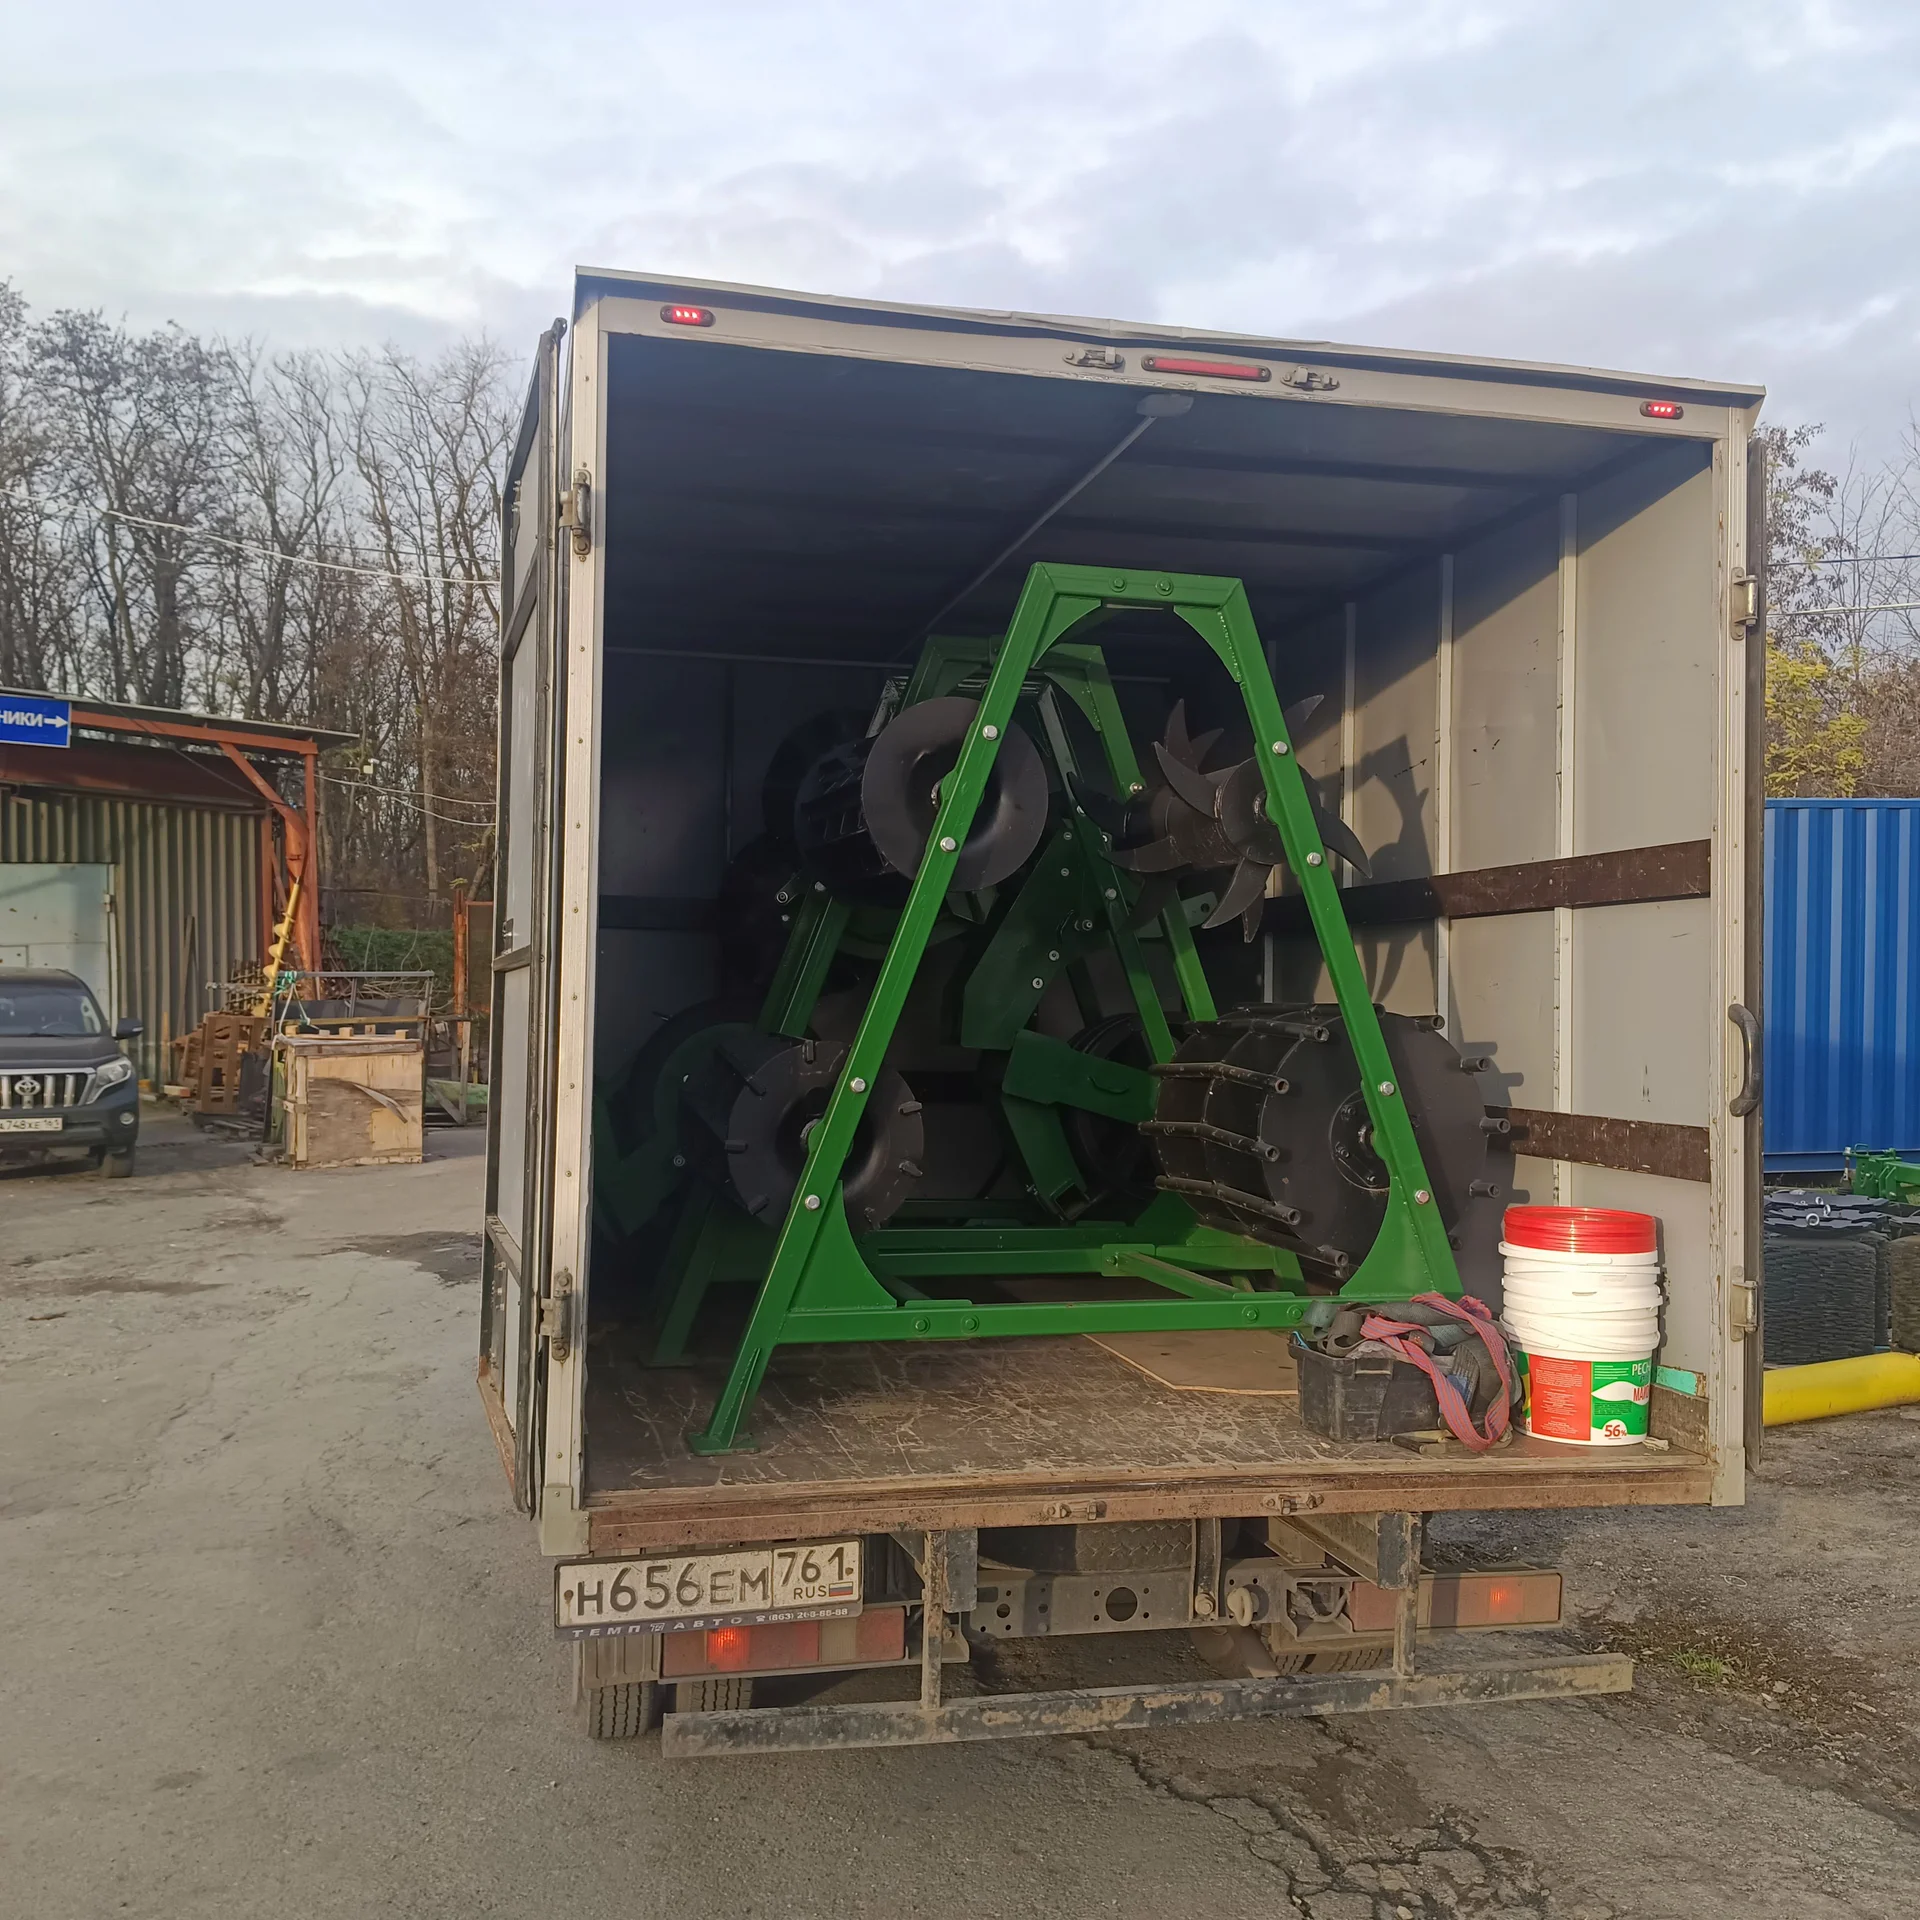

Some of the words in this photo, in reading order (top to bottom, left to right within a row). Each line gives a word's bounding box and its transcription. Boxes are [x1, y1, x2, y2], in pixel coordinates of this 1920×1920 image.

[777, 1546, 844, 1587] 761
[793, 1585, 827, 1600] RUS
[572, 1625, 641, 1638] ТЕМП
[673, 1616, 742, 1629] АВТО
[768, 1612, 794, 1621] (863)
